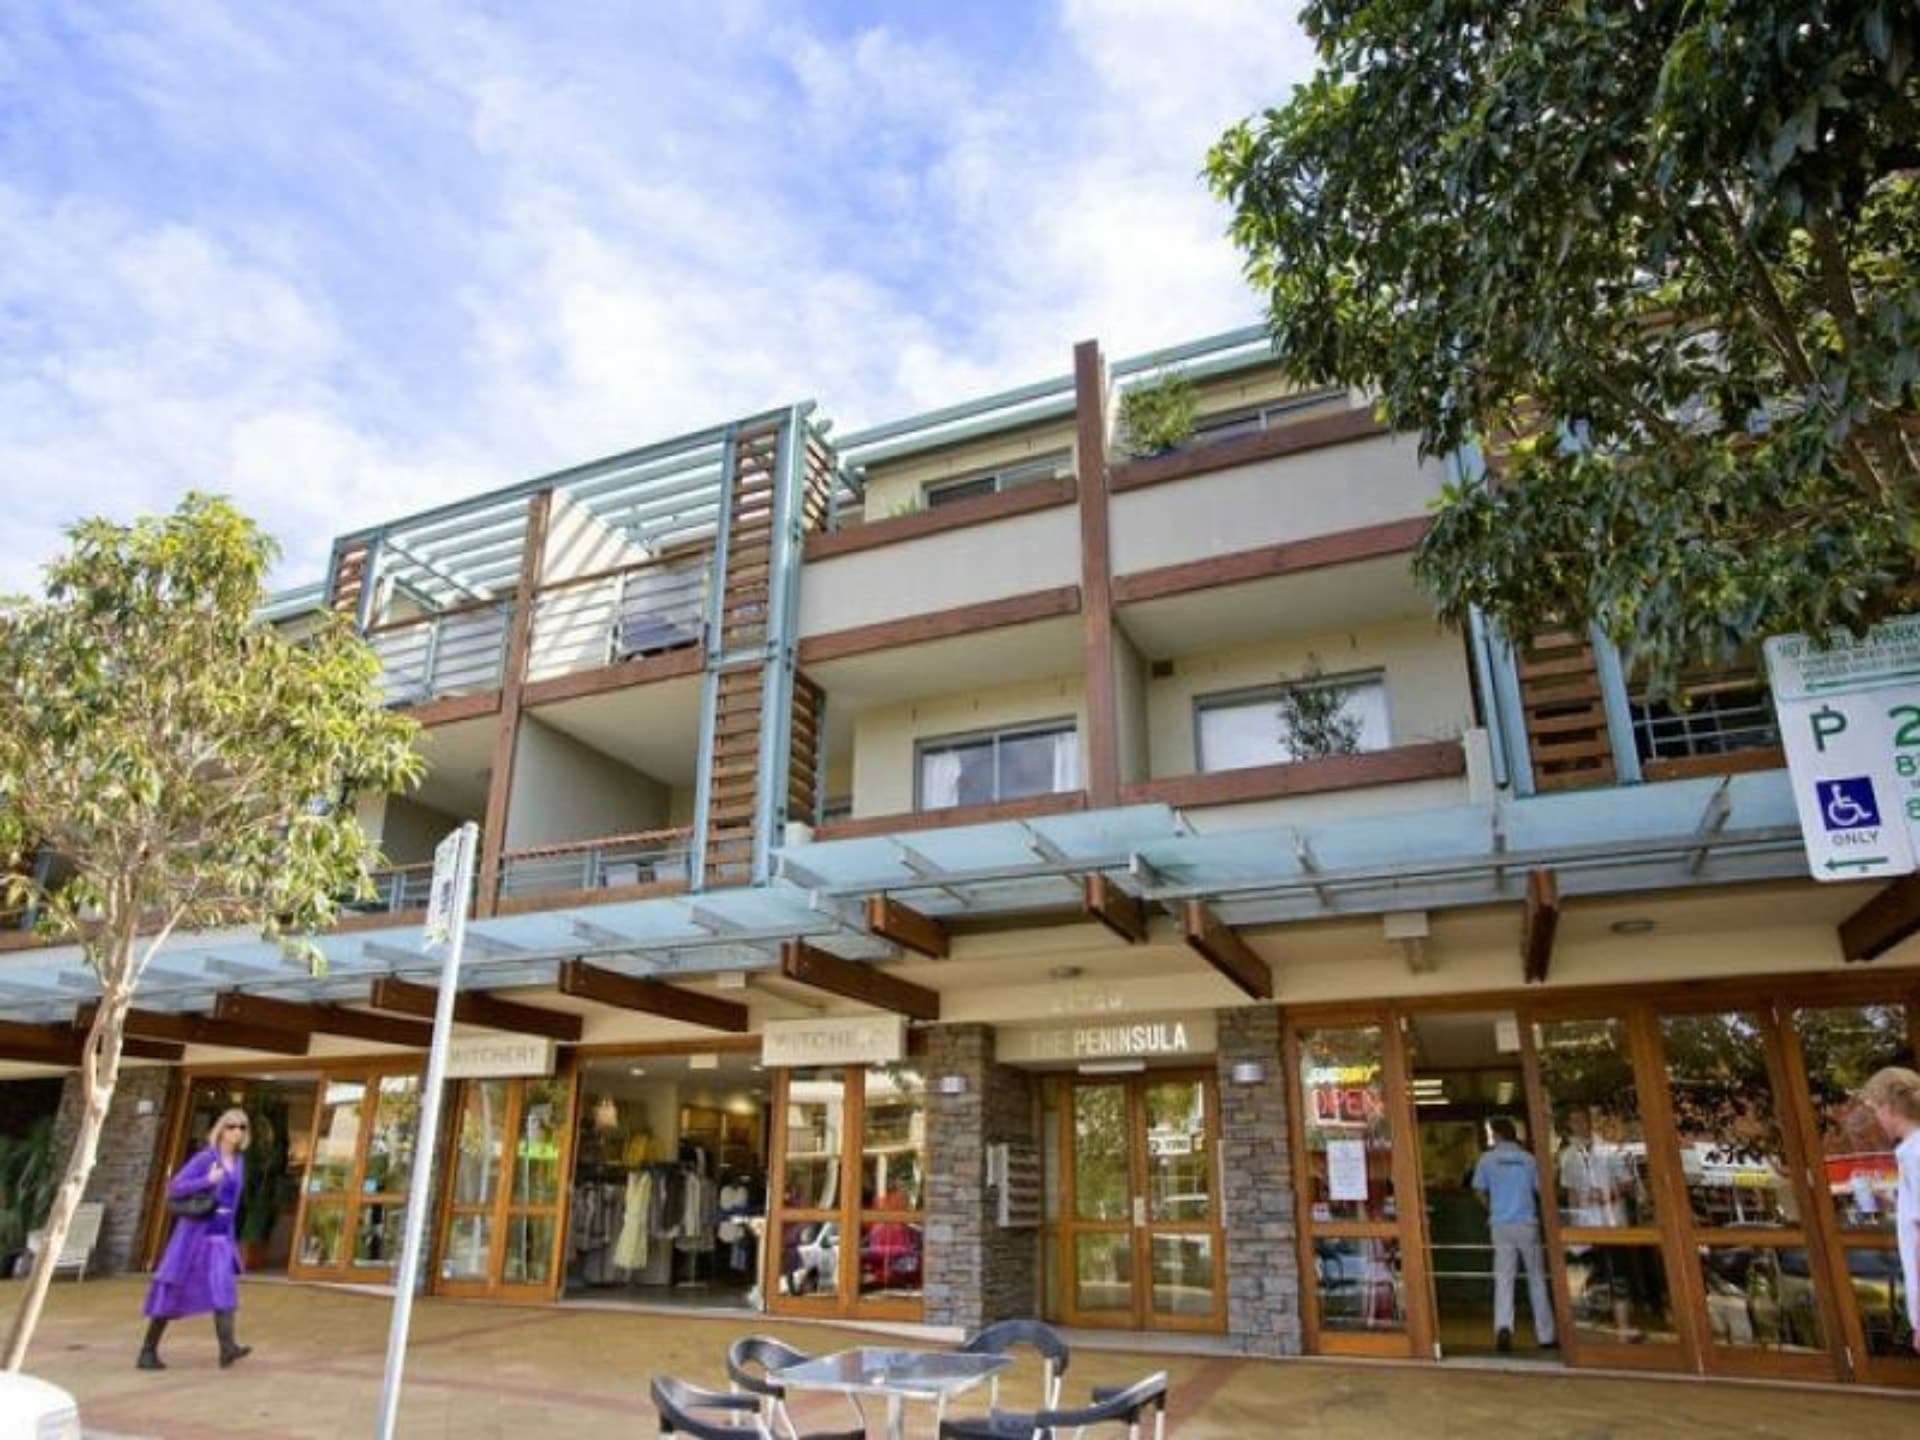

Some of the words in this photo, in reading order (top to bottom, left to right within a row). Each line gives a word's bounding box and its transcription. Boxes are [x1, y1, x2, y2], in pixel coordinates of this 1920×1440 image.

[1809, 706, 1848, 753] P
[1831, 831, 1879, 847] ONLY
[1072, 1021, 1188, 1056] PENINSULA
